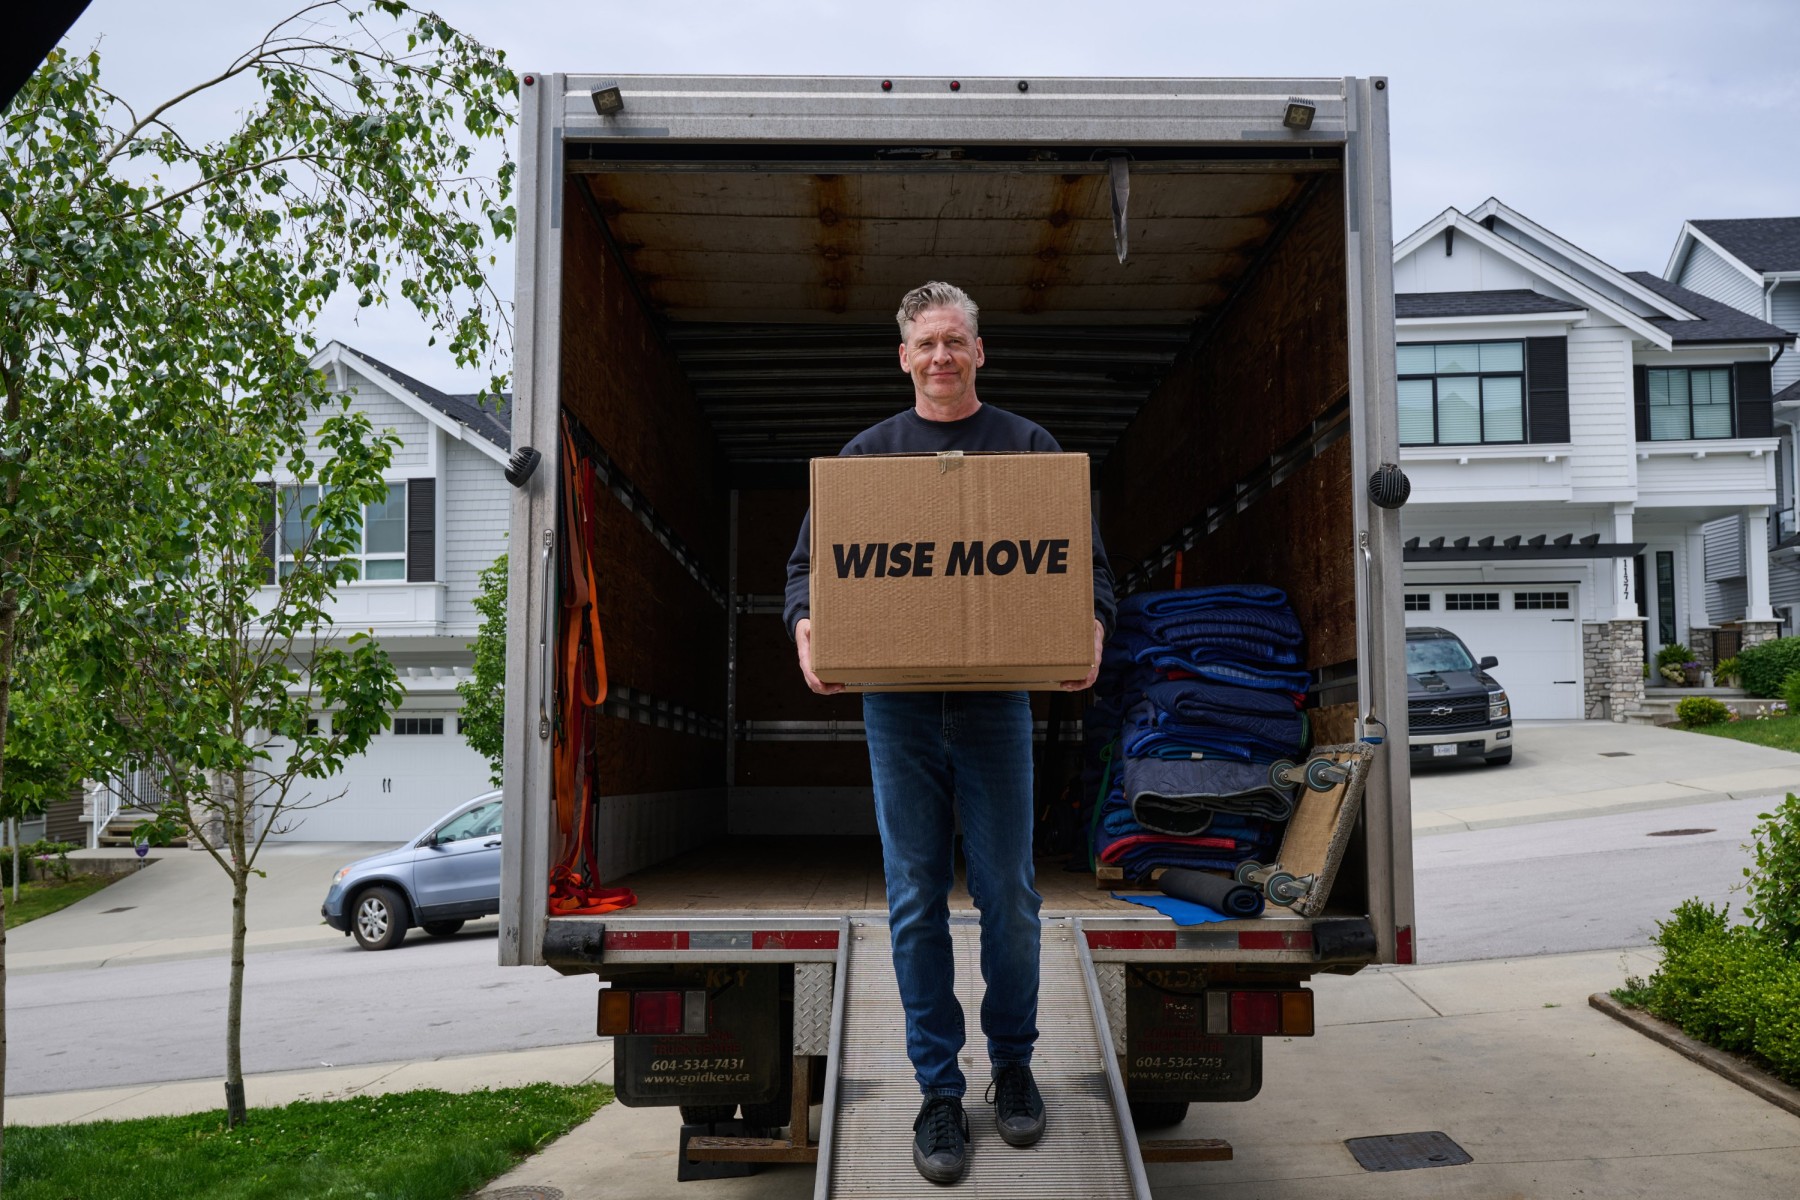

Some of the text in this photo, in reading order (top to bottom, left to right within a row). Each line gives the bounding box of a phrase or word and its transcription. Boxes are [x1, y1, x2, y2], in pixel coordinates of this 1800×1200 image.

[832, 538, 1070, 579] WISE MOVE
[651, 1058, 745, 1071] 604-534-7431
[1136, 1056, 1223, 1068] 604-534-743
